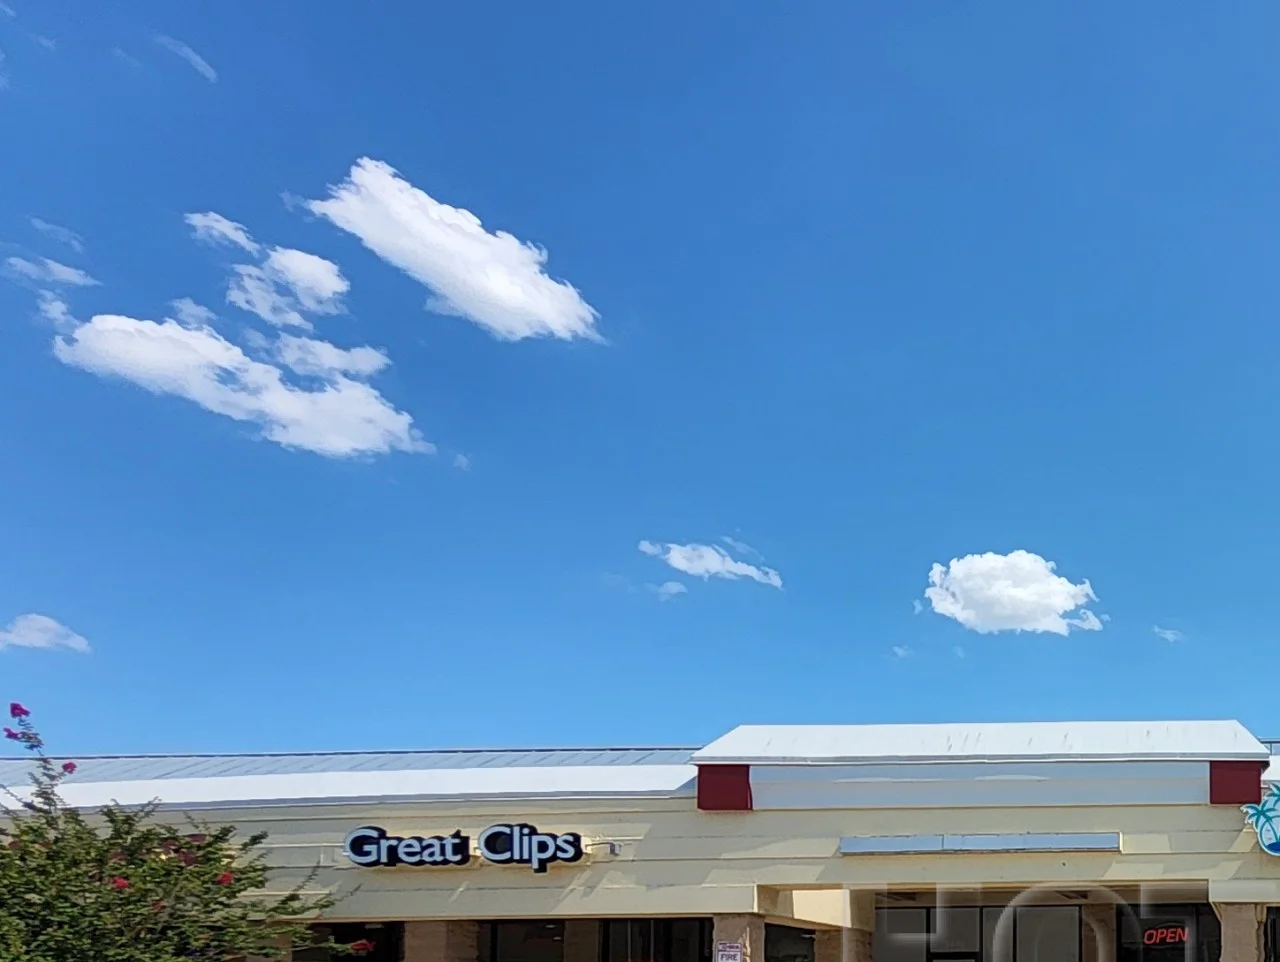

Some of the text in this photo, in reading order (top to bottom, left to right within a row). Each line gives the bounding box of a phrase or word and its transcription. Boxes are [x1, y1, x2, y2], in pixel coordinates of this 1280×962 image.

[343, 823, 582, 872] Great Clips
[1144, 927, 1188, 944] OPEN
[720, 953, 738, 962] FIRE
